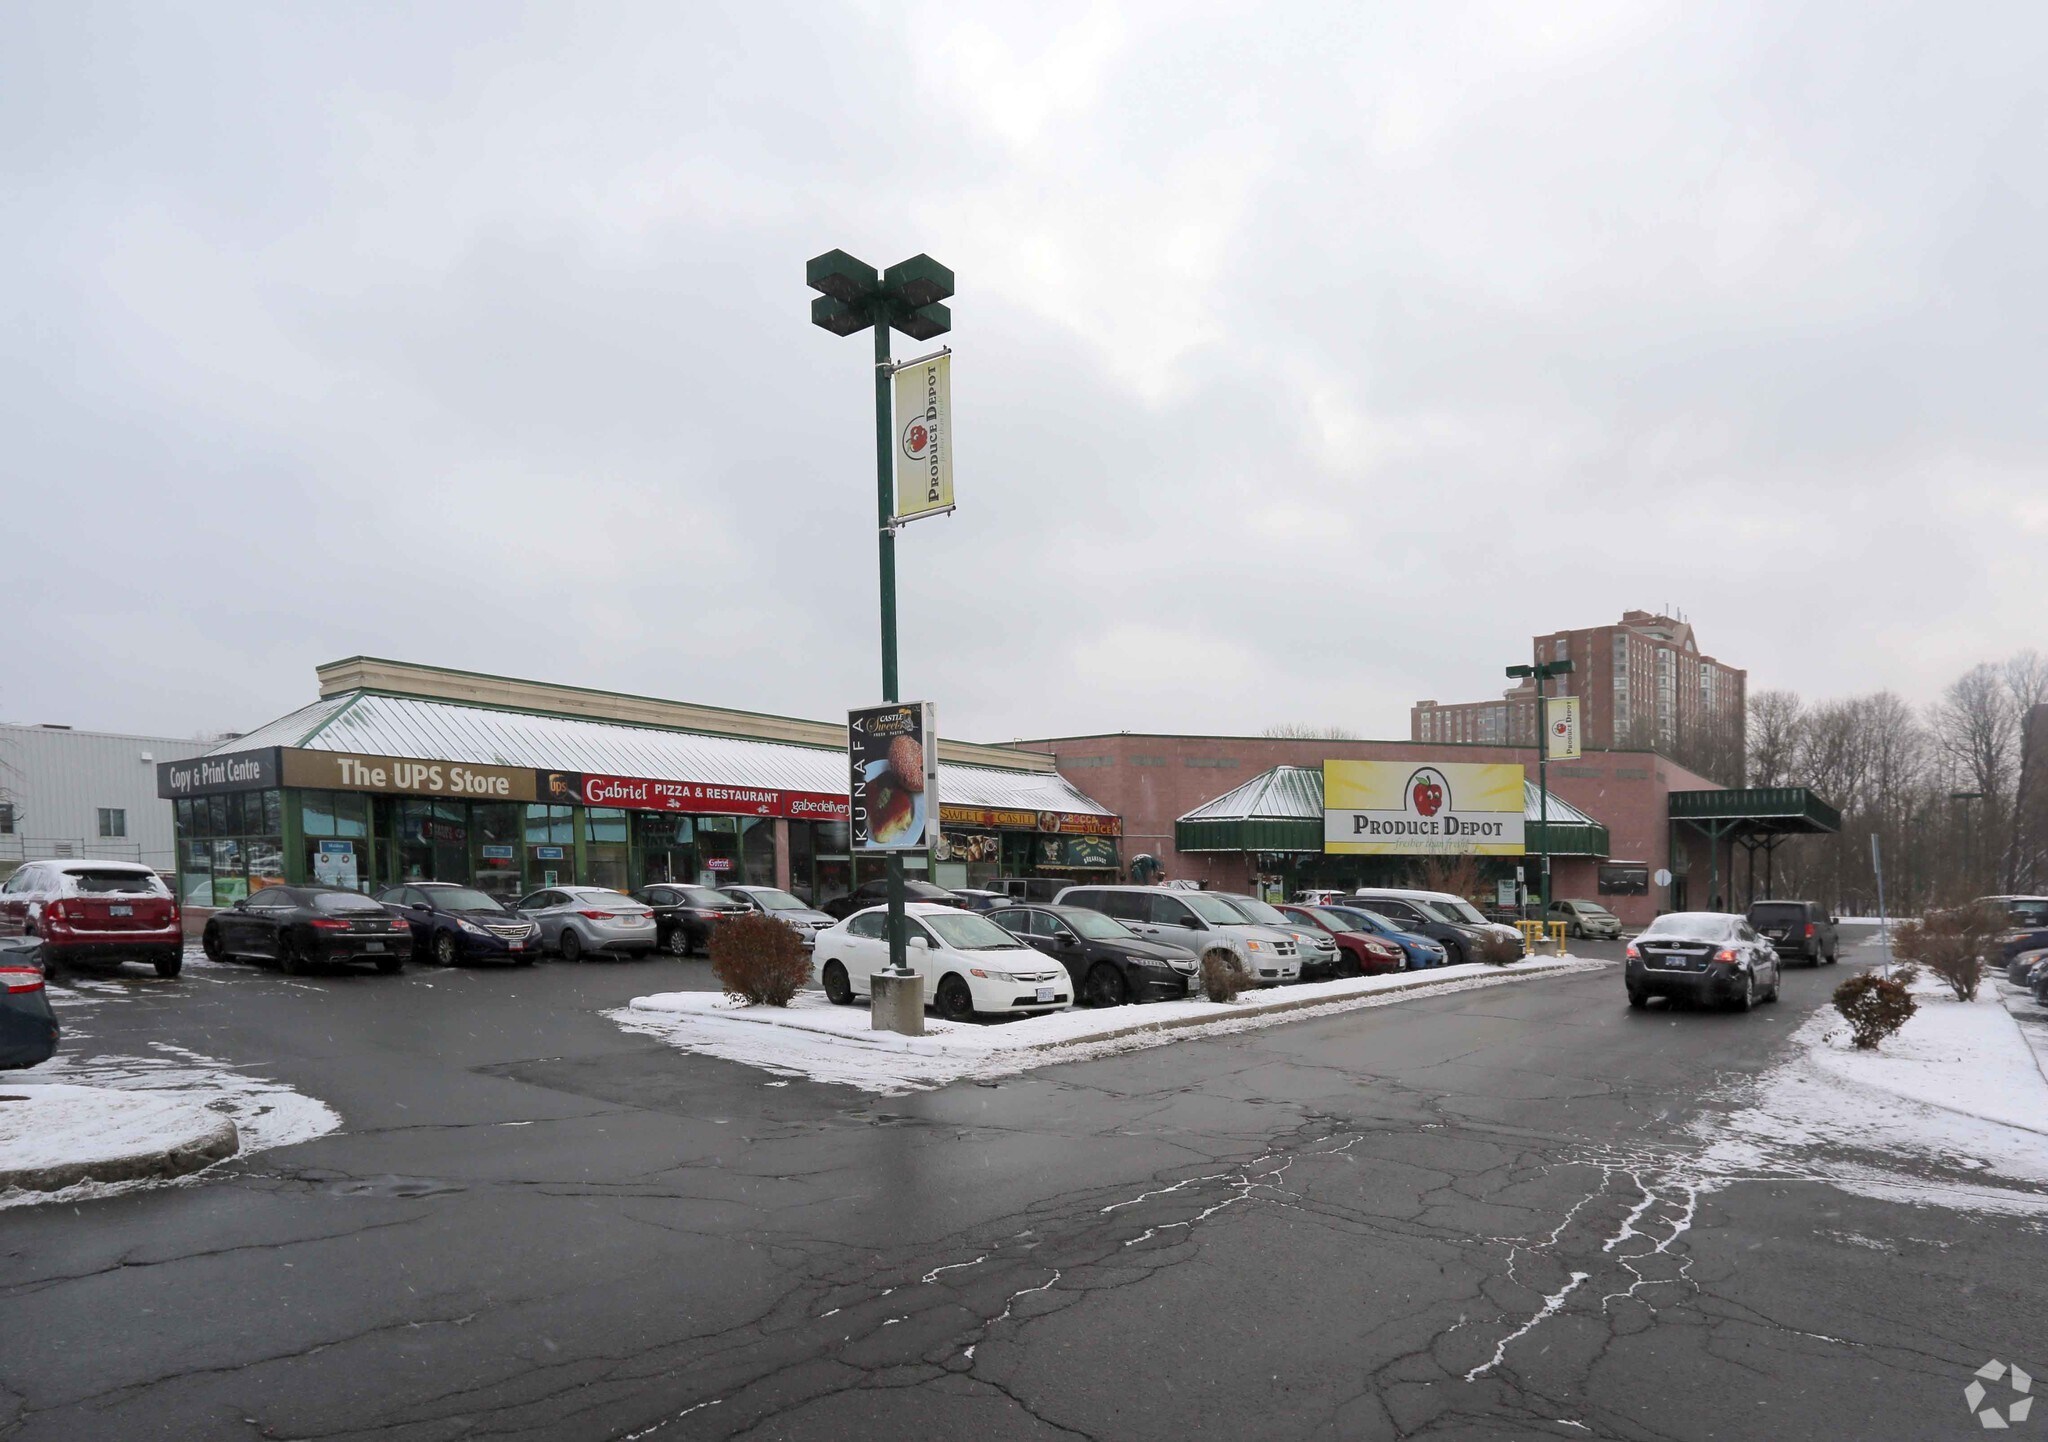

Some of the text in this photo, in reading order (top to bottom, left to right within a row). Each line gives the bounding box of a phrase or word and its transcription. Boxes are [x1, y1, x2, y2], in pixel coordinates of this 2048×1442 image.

[926, 366, 939, 503] PRODUCE DEPOT
[880, 714, 904, 723] CASTLE
[169, 758, 260, 792] Copy & Print Centre
[337, 758, 510, 795] The UPS Store
[852, 717, 867, 841] KUNAFA
[550, 781, 567, 795] ups
[586, 778, 779, 804] Gabriel PIZZA & RESTAURANT
[940, 807, 1036, 825] SWEET CASTLE
[1068, 814, 1098, 824] BOCCA
[1353, 815, 1503, 836] PRODUCE DEPOT
